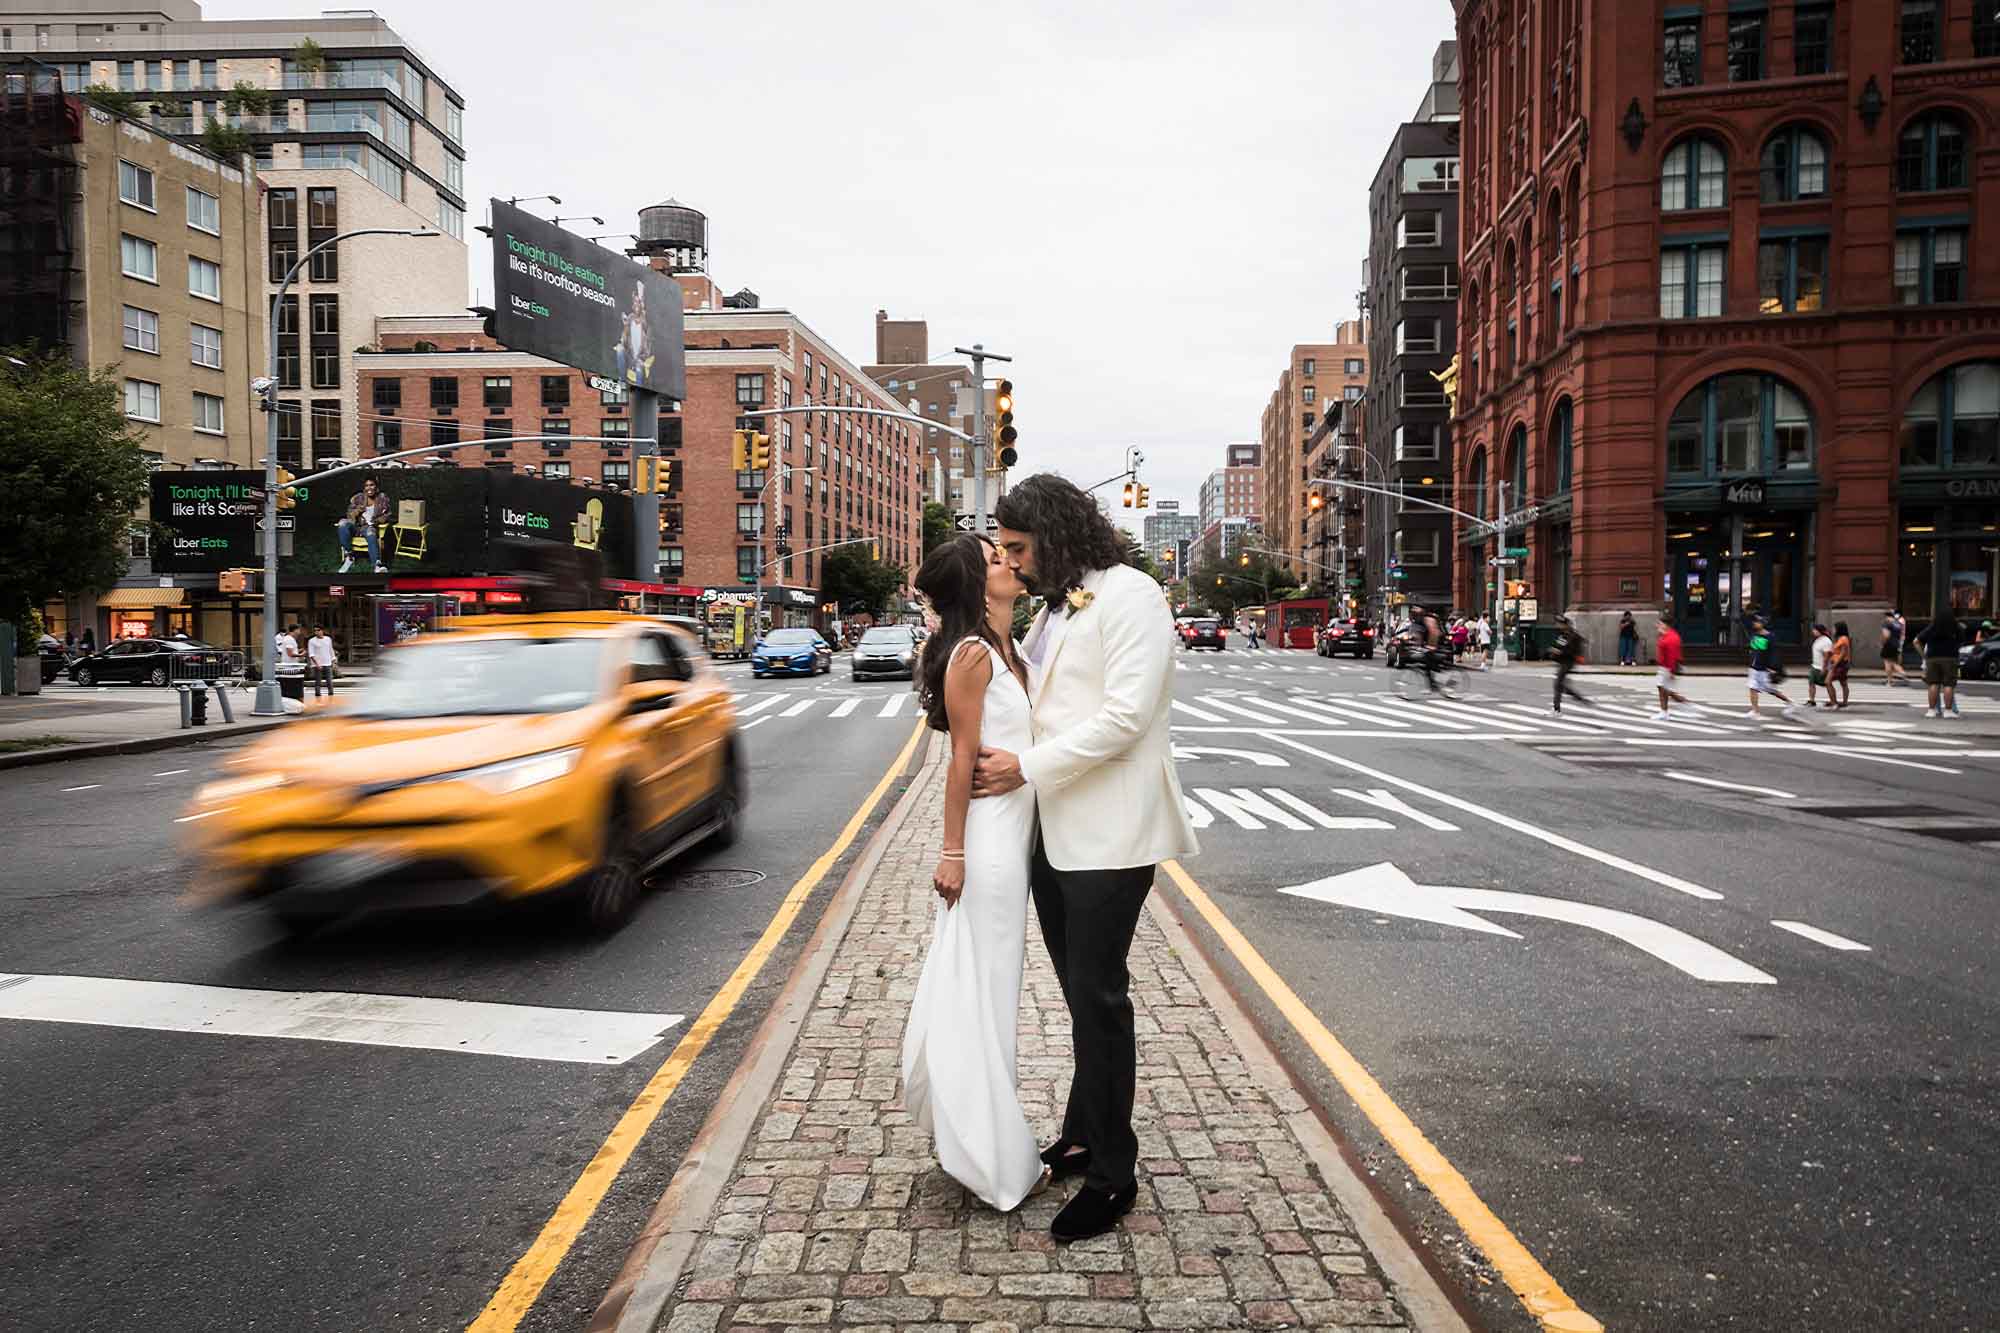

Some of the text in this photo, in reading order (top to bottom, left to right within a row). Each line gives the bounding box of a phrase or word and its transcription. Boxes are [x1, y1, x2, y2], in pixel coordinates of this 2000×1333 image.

[506, 234, 548, 265] Tonight,
[560, 258, 573, 274] be
[575, 266, 605, 289] eating
[509, 254, 616, 308] like it's rooftop season
[511, 295, 530, 310] Uber
[531, 302, 550, 317] Eats
[169, 485, 224, 502] Tonight,
[226, 485, 238, 499] I'll
[172, 502, 195, 516] like
[197, 502, 216, 516] it's
[502, 508, 526, 526] Uber
[527, 512, 549, 529] Eats
[962, 519, 975, 527] ON
[173, 537, 229, 549] Uber Eats
